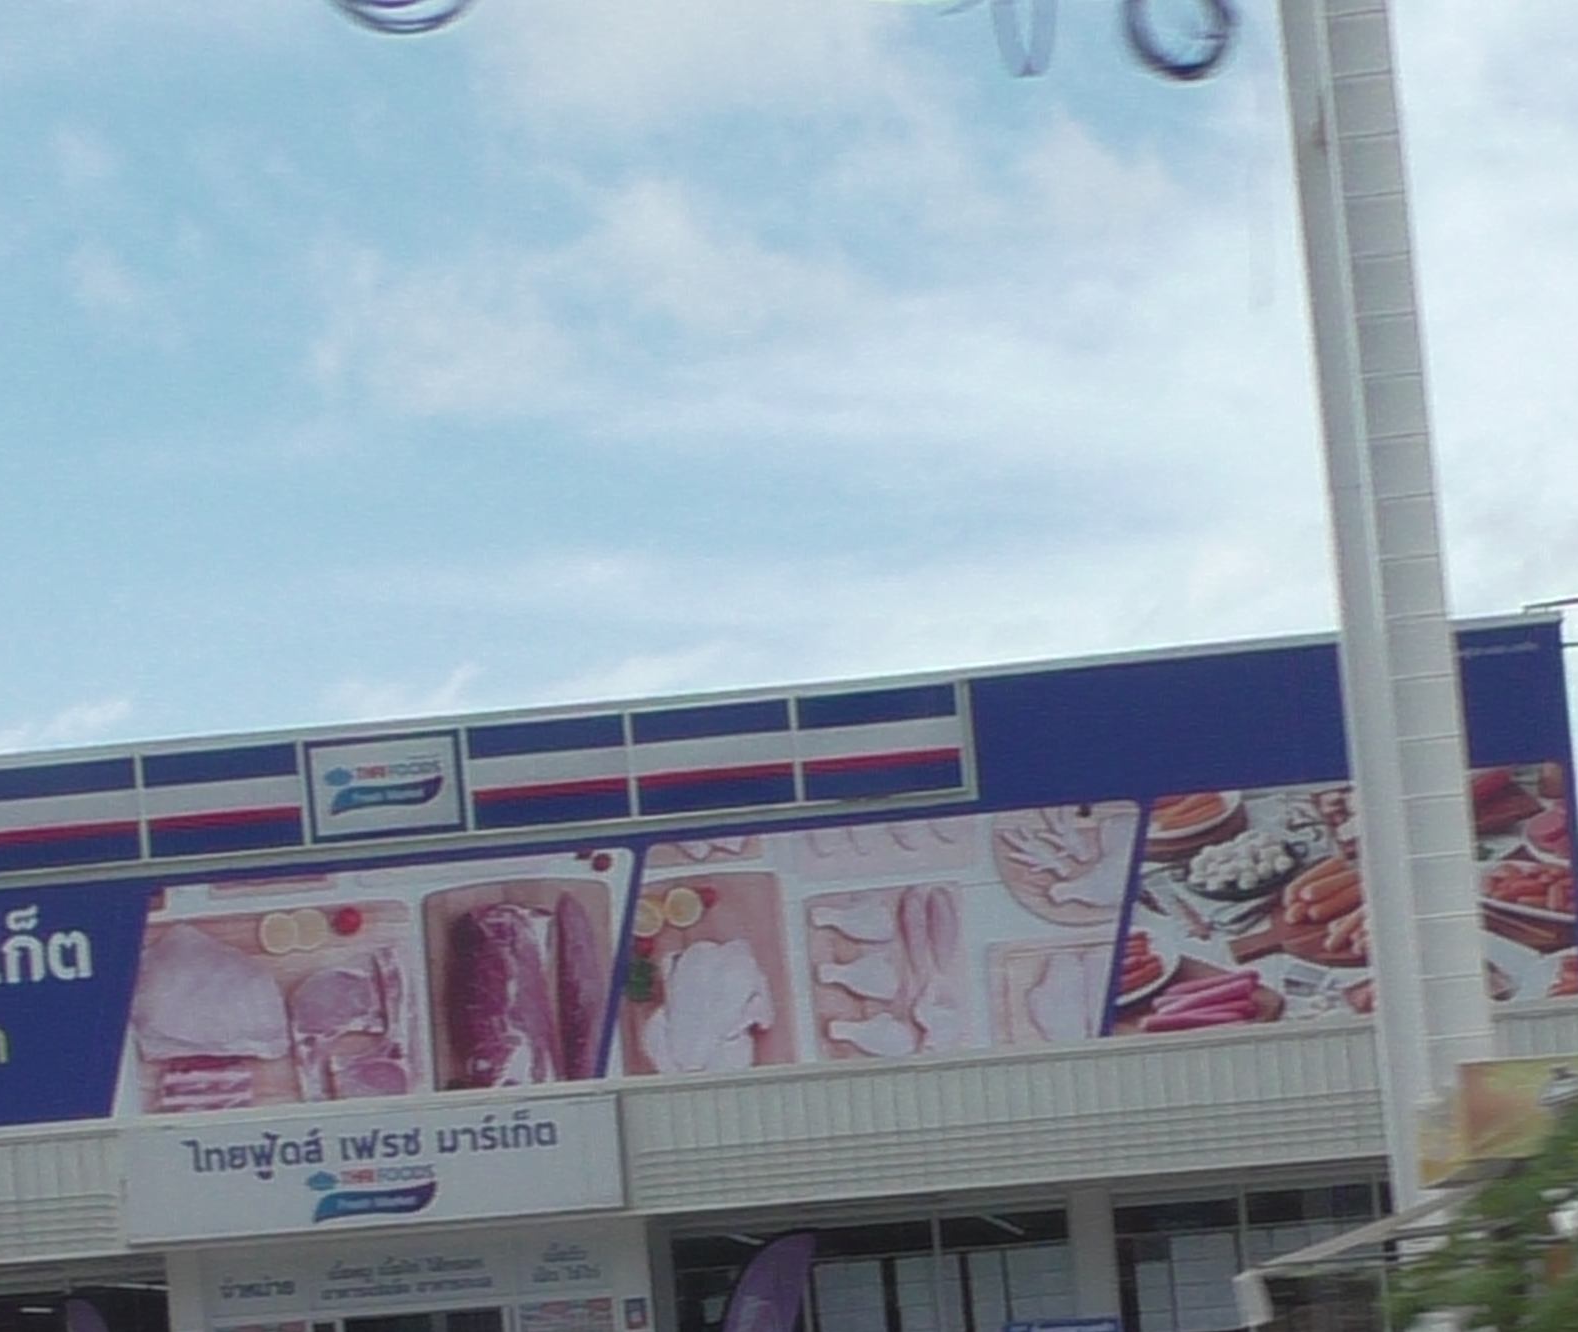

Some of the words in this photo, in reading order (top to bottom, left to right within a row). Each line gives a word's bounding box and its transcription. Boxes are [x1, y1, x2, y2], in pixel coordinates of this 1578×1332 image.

[181, 1127, 324, 1180] ไทยฟู้ดส์
[436, 1108, 559, 1154] มาร์เก็ต
